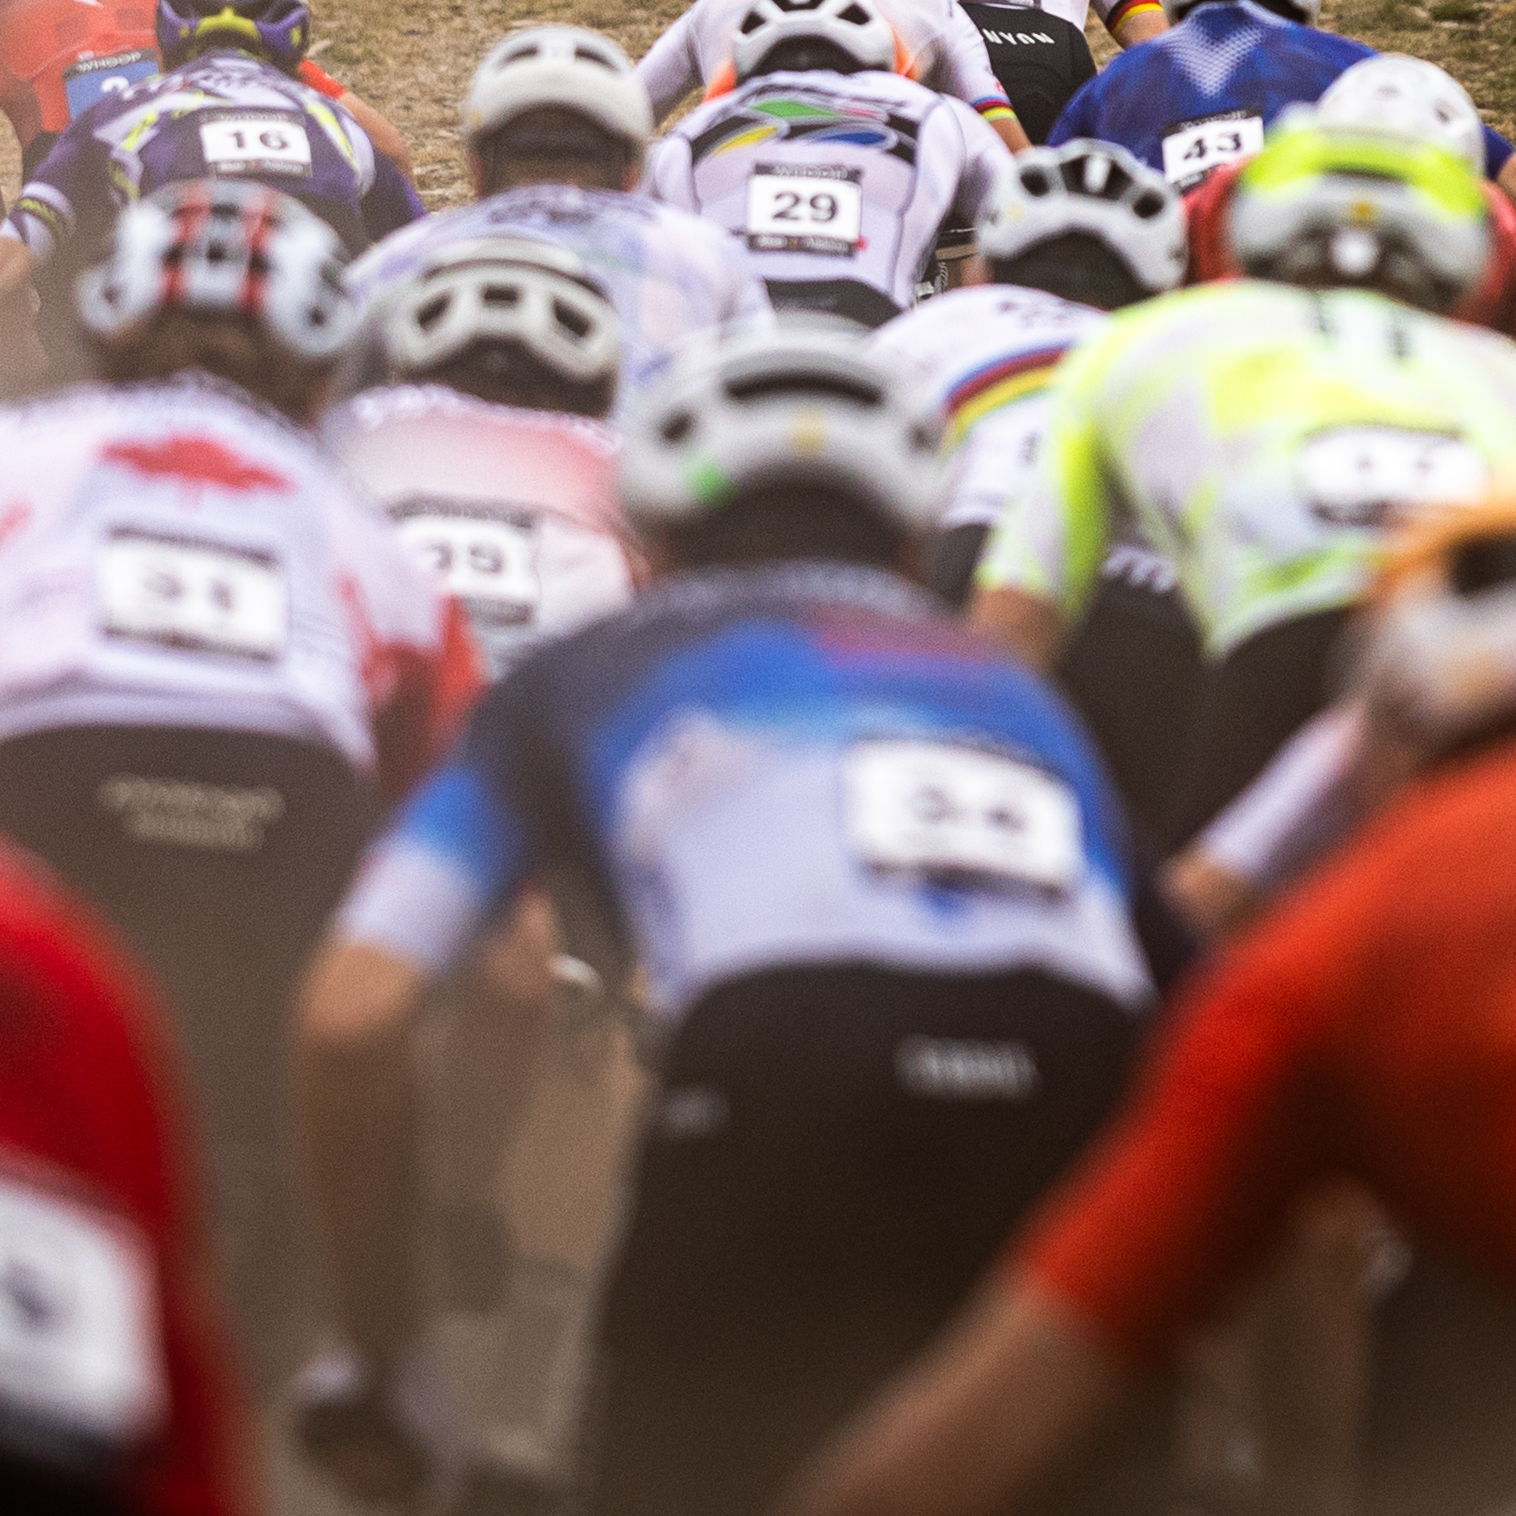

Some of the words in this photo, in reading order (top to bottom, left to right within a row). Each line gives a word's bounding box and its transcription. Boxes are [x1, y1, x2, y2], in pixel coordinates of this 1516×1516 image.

[228, 130, 289, 151] 16
[1184, 132, 1242, 160] 43
[772, 190, 838, 222] 29
